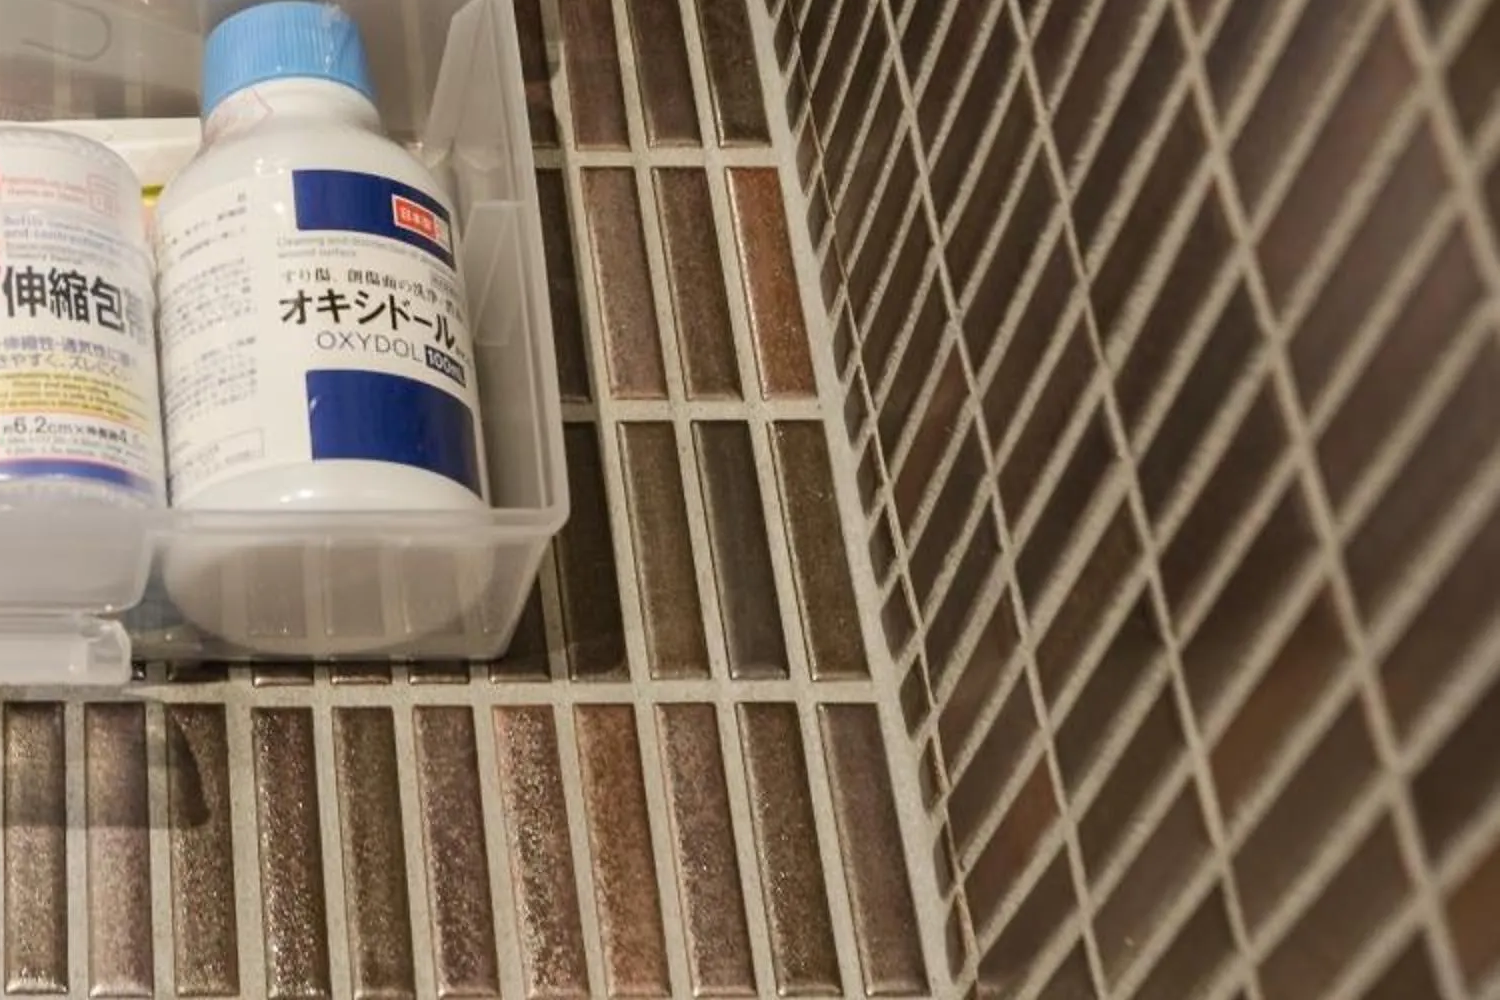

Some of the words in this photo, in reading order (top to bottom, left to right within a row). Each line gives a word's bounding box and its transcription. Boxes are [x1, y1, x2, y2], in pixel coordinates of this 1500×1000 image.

[279, 287, 455, 349] オキシドール
[316, 330, 423, 362] OXYDOL
